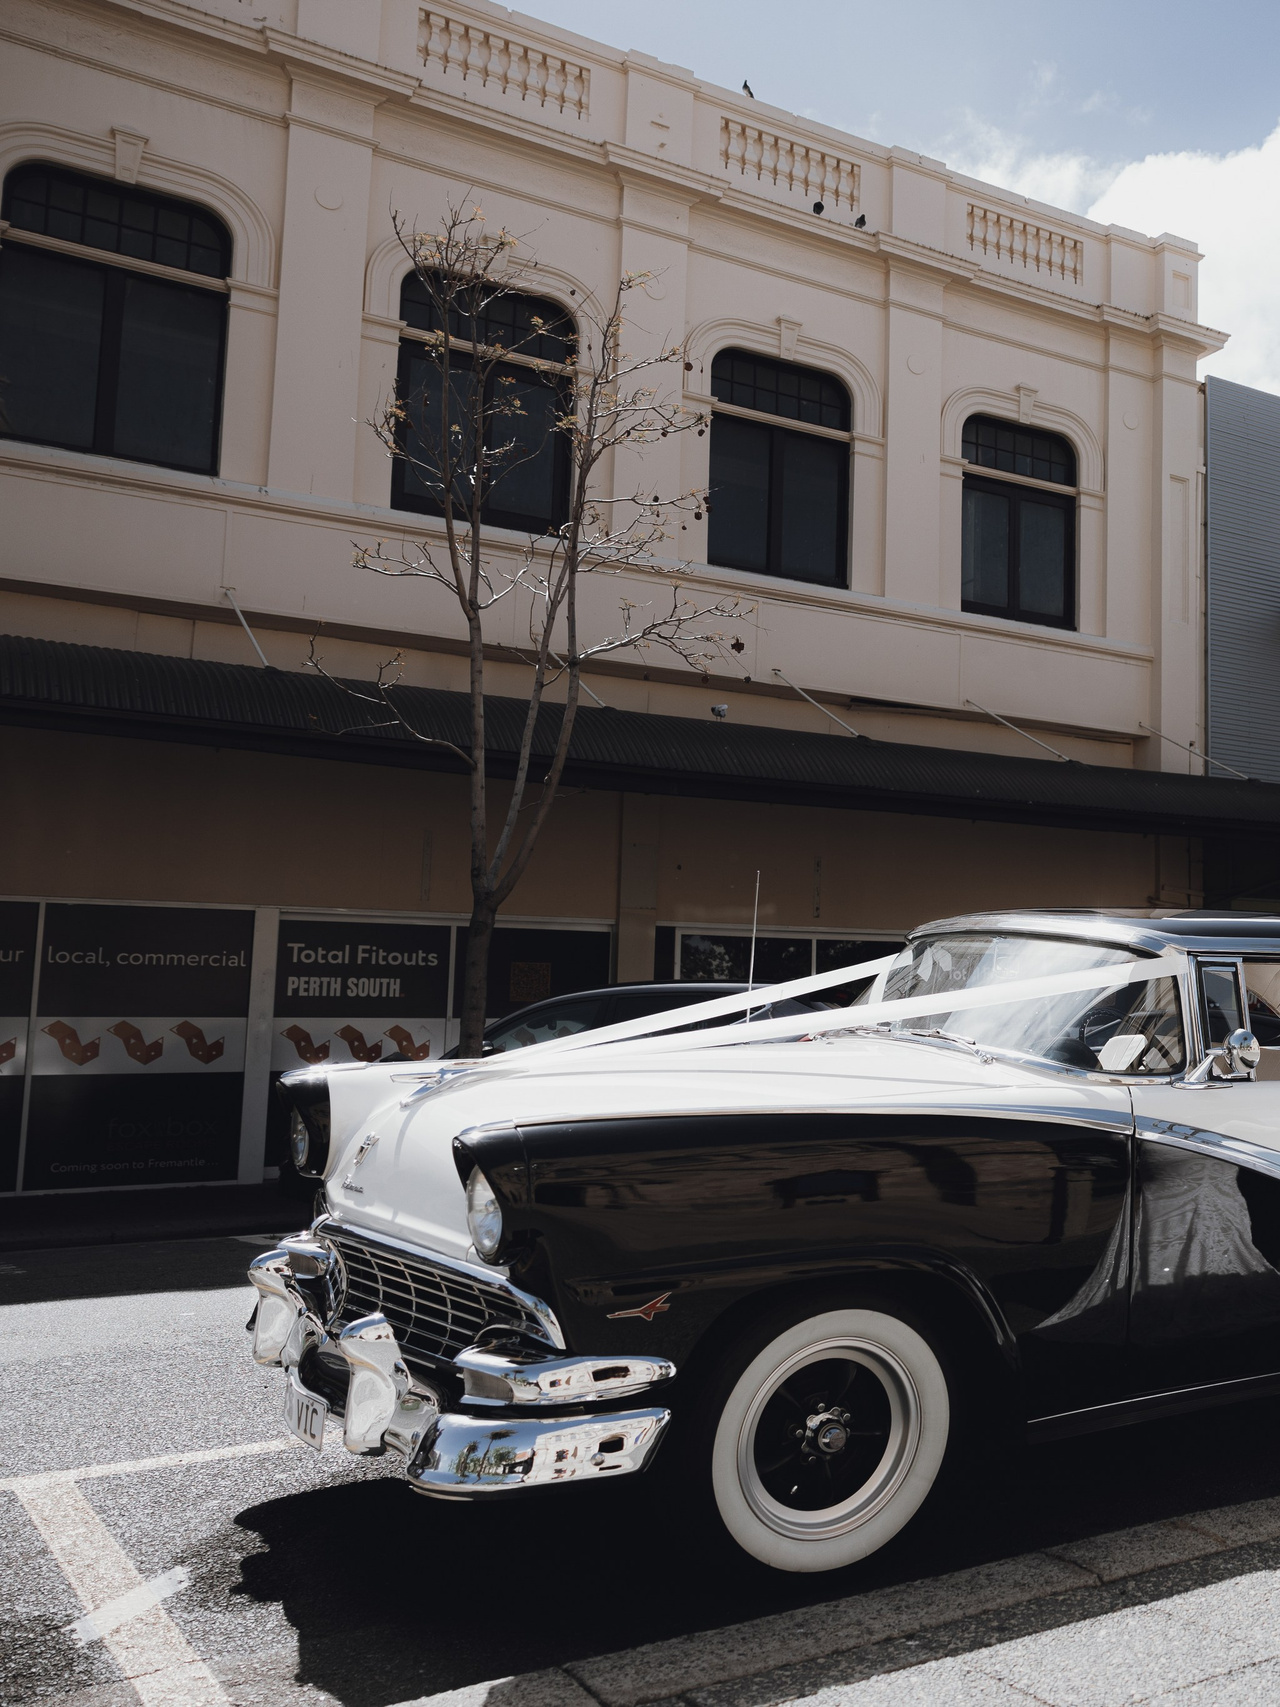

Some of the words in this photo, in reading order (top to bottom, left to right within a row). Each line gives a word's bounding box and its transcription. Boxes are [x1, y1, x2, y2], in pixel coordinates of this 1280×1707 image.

[47, 945, 111, 968] local,
[116, 949, 247, 968] commercial
[286, 942, 350, 965] Total
[356, 944, 439, 967] Fitouts
[286, 976, 342, 997] PERTH
[104, 1117, 153, 1139] fox
[167, 1117, 218, 1137] box
[50, 1161, 97, 1174] Coming
[100, 1160, 130, 1172] soon
[132, 1159, 145, 1170] to
[297, 1398, 319, 1440] VIC
